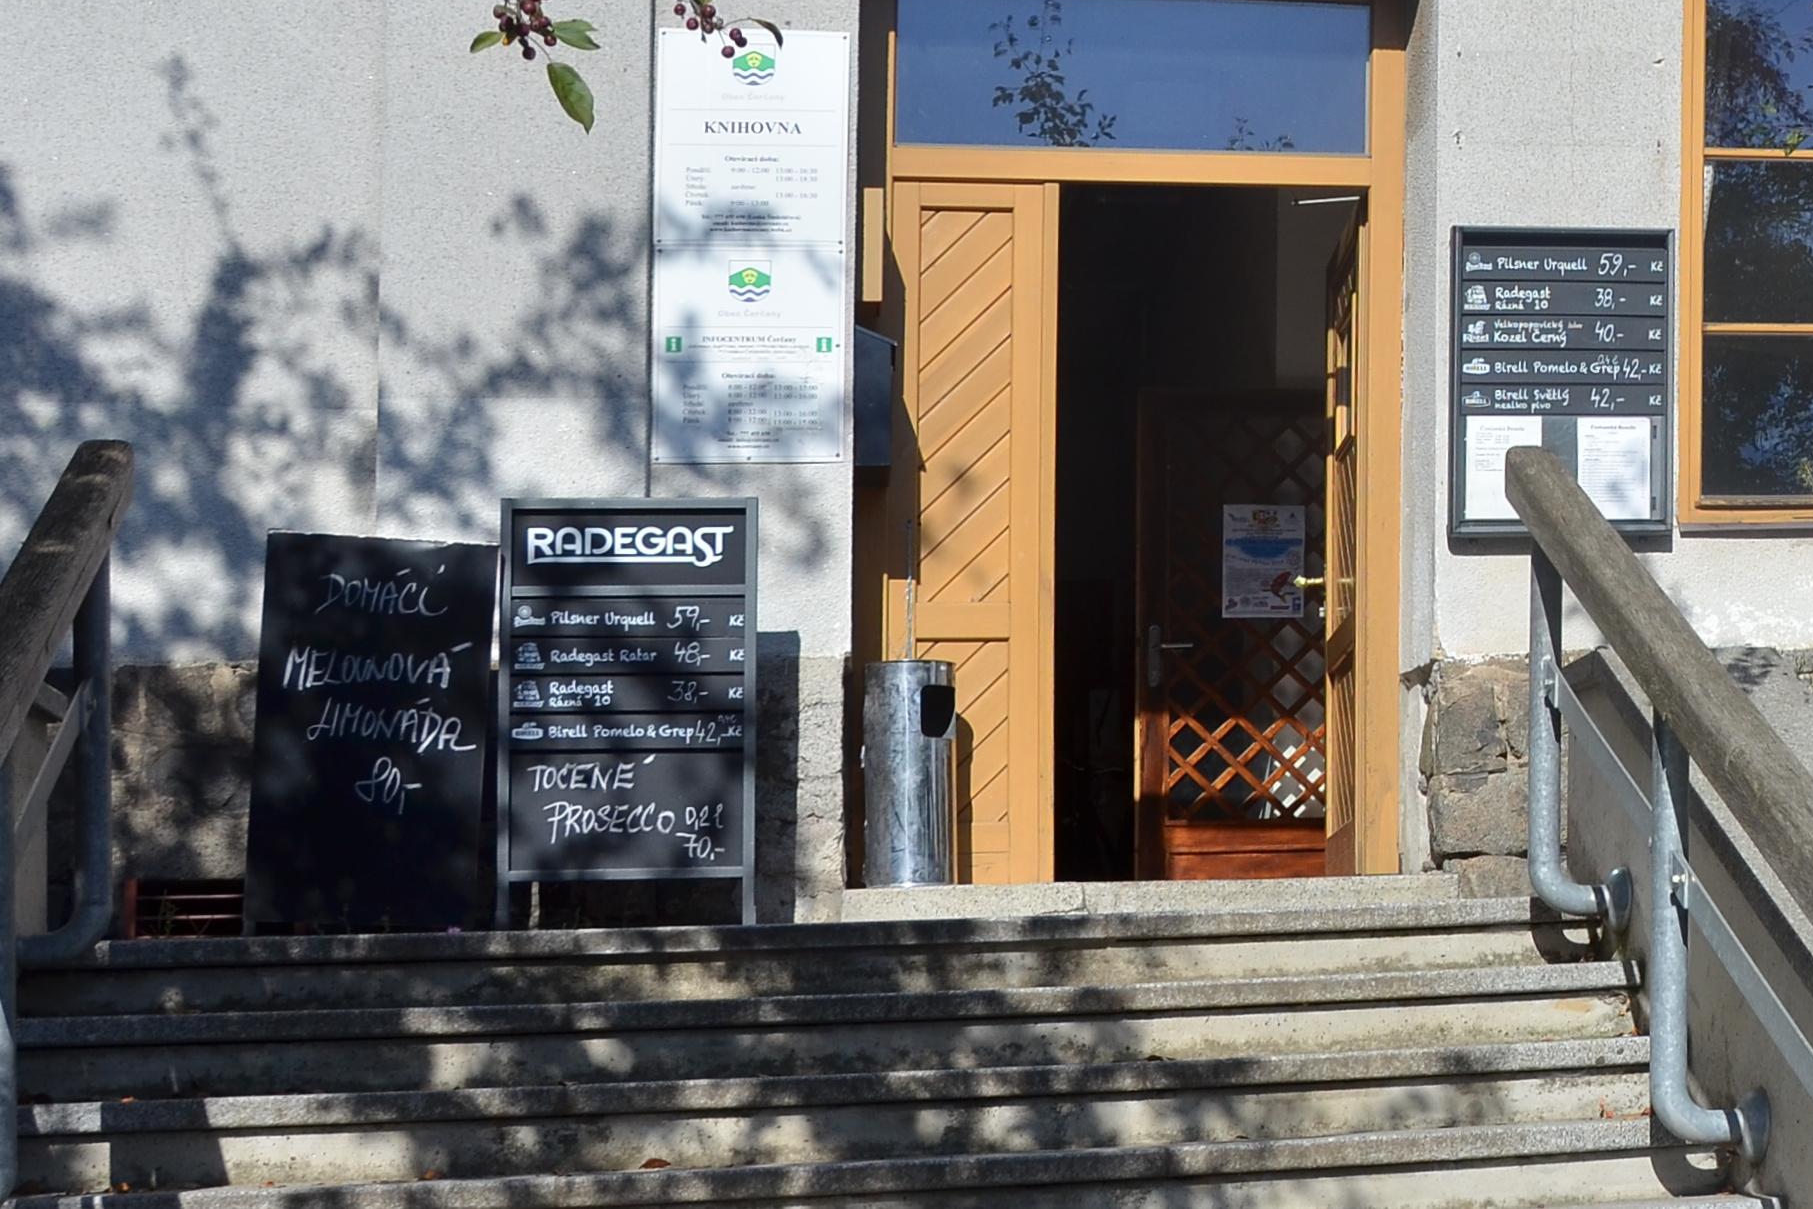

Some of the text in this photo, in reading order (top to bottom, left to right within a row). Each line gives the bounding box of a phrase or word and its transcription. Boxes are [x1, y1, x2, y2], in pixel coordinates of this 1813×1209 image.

[703, 121, 802, 134] KNIHOVNA
[1497, 257, 1540, 270] Pilsner
[1543, 257, 1588, 277] Urquell
[1650, 260, 1664, 272] Kč
[1495, 285, 1551, 303] Radegast
[1649, 294, 1663, 306] Kč
[1495, 300, 1525, 311] Rázná
[1534, 300, 1549, 310] 10
[1494, 319, 1564, 333] Velkopopovický
[1493, 330, 1527, 342] Kozel
[1532, 328, 1567, 348] Černý
[1648, 328, 1662, 340] Kč
[1494, 361, 1528, 374] Birell
[1533, 361, 1578, 374] Pomelo
[1579, 362, 1588, 374] &
[1590, 362, 1620, 381] Grep
[1648, 363, 1662, 375] Kč
[1494, 388, 1529, 400] Birell
[1533, 388, 1570, 406] Světlý
[1648, 394, 1662, 406] Kč
[1494, 401, 1551, 414] nealko pivo
[527, 525, 734, 568] RADEGAST
[551, 610, 600, 625] Pilsner
[604, 611, 656, 632] Urquell
[729, 614, 745, 627] Kč
[550, 647, 615, 667] Radegast
[619, 648, 657, 662] Ratar
[729, 648, 745, 661] Kč
[549, 679, 614, 699] Radegast
[728, 686, 744, 699] Kč
[548, 695, 582, 708] Rázná
[594, 695, 611, 707] 10
[307, 697, 477, 754] LIMONÁDA
[548, 724, 588, 739] Birell
[593, 724, 645, 739] Pomelo
[646, 724, 656, 739] &
[658, 724, 694, 745] Grep
[728, 725, 743, 737] Kč
[542, 801, 675, 844] PROSECCO
